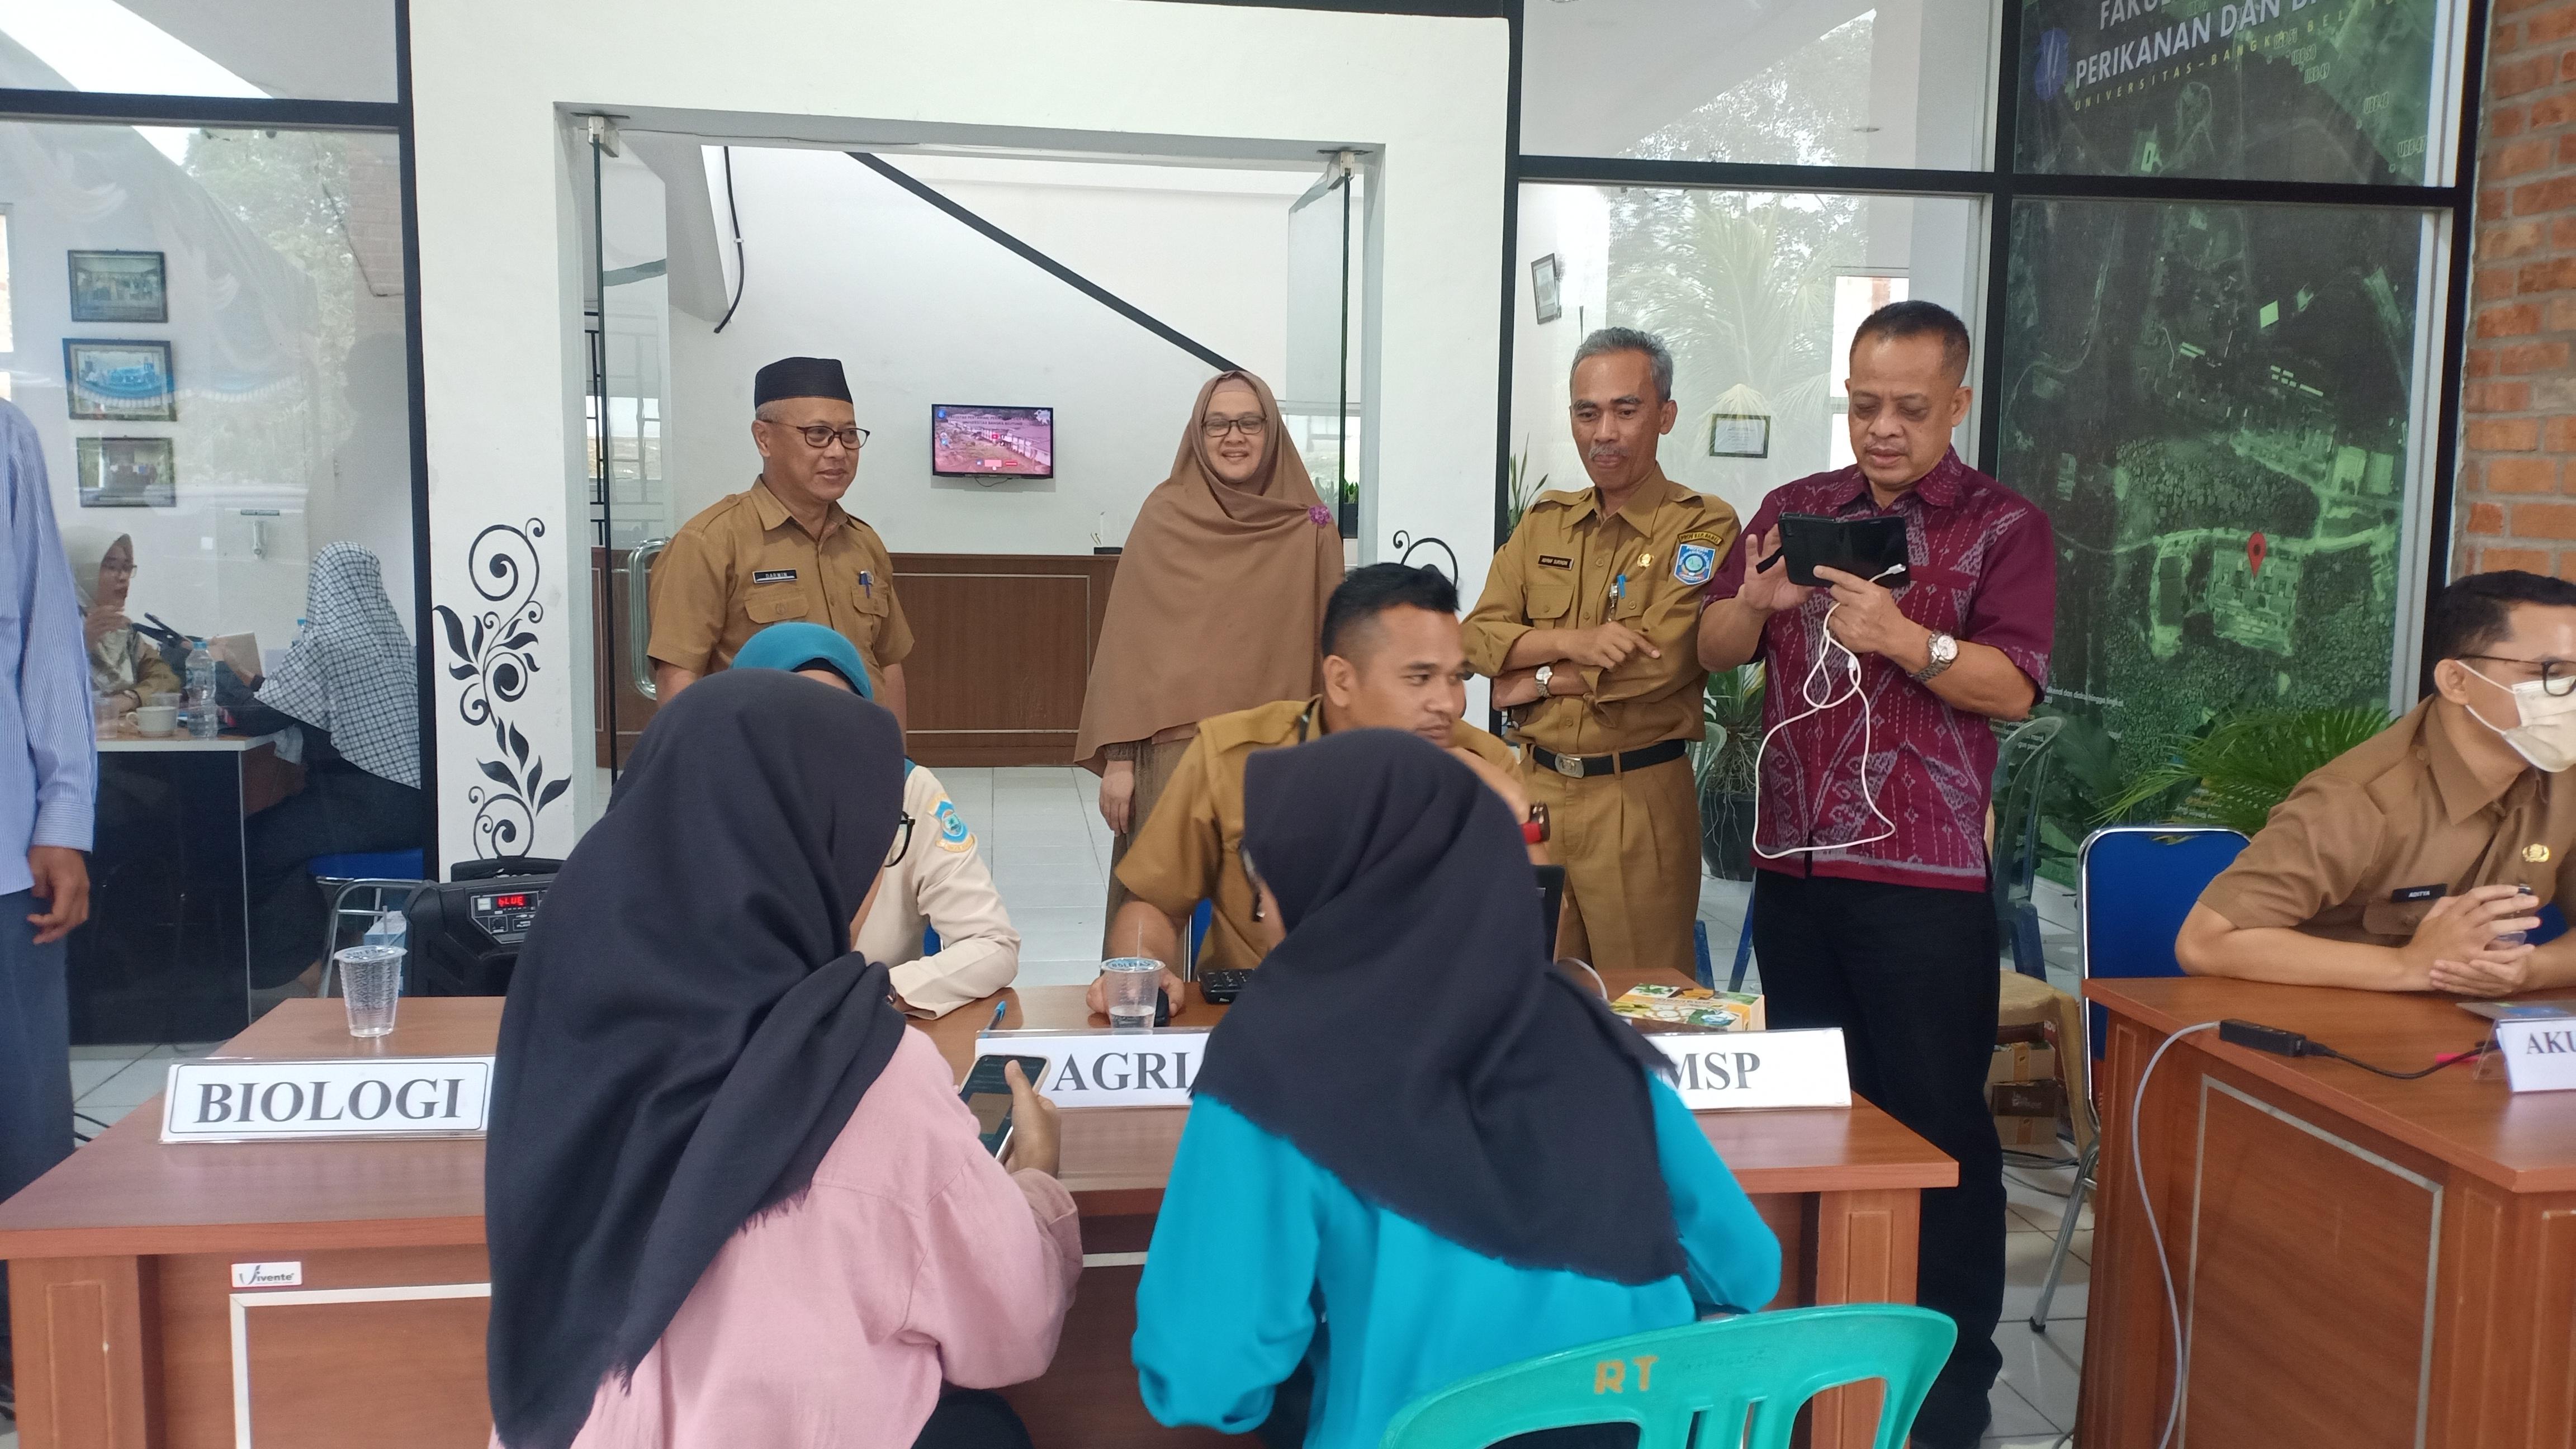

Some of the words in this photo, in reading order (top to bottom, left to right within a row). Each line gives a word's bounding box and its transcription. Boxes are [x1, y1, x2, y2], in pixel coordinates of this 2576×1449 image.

[2076, 12, 2210, 89] PERIKANAN
[2220, 0, 2280, 37] DAN
[2408, 890, 2430, 898] ADITYA
[1052, 1052, 1190, 1092] AGRI
[1660, 1052, 1760, 1090] MSP
[193, 1078, 465, 1123] BIOLOGI
[239, 1265, 294, 1285] Vivente
